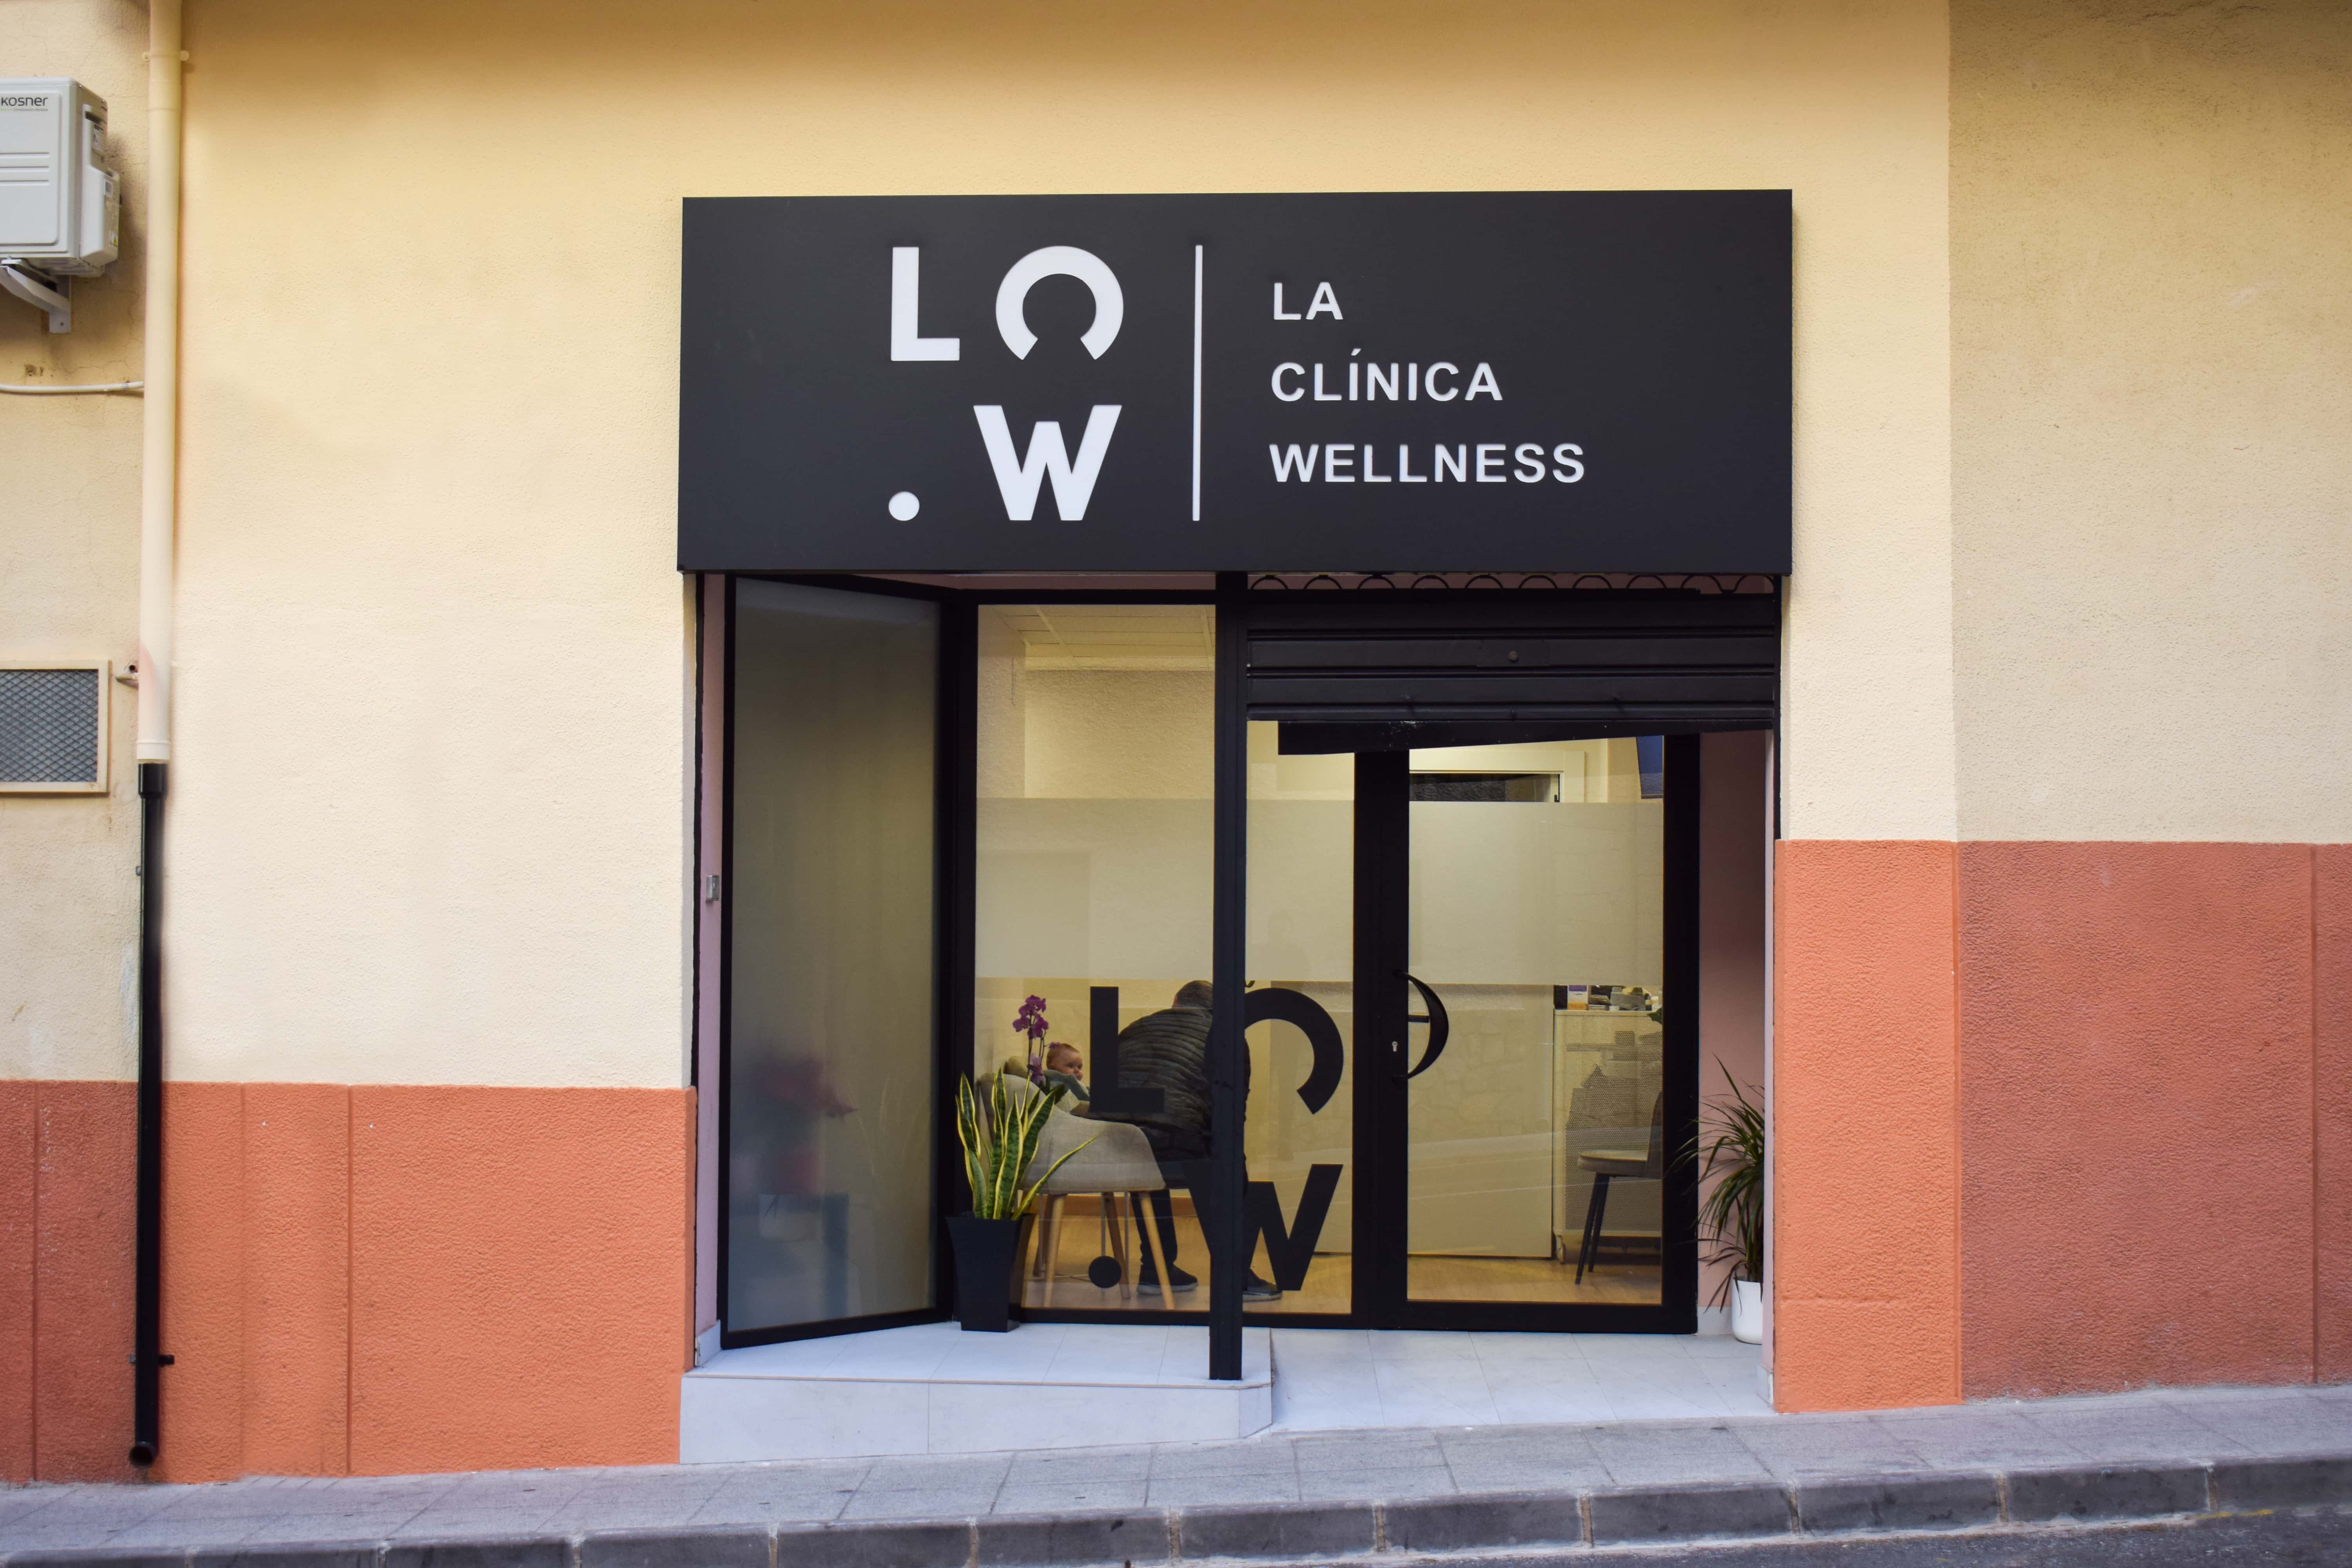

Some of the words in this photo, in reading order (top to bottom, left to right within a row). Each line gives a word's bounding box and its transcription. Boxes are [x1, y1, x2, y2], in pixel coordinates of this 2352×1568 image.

[1273, 281, 1344, 321] LA
[1270, 348, 1503, 402] CLÍNICA
[1269, 443, 1585, 483] WELLNESS
